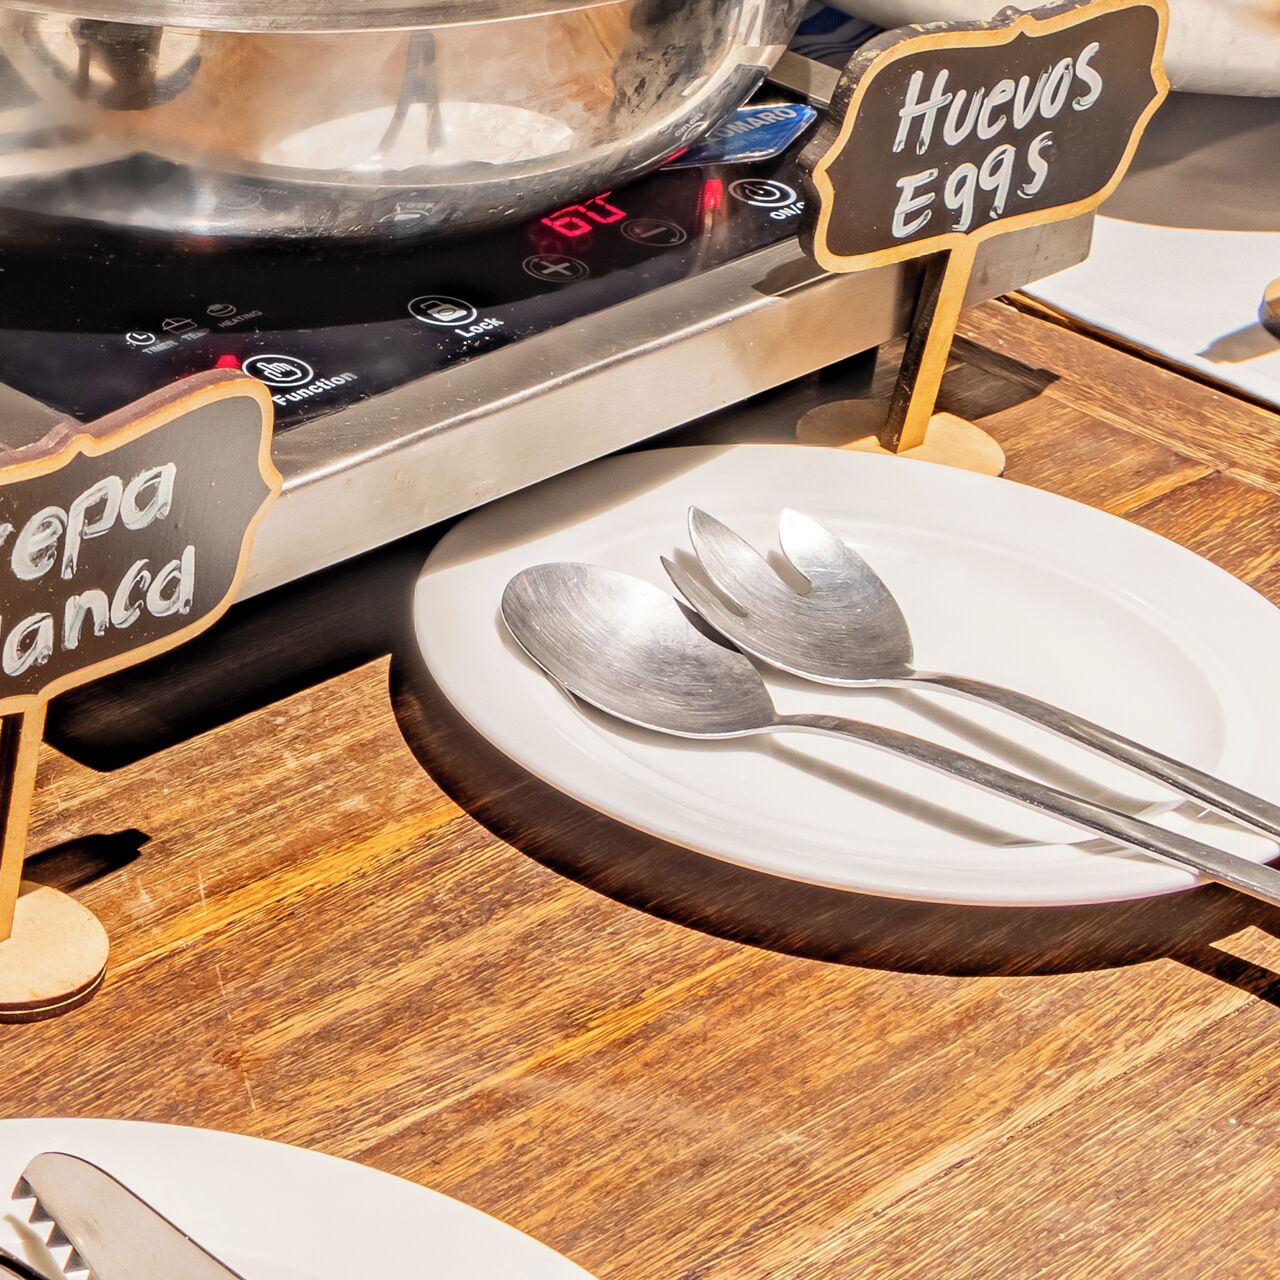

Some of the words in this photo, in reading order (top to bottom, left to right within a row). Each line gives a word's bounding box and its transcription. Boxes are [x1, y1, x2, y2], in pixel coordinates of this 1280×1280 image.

[891, 131, 1054, 238] Eggs
[217, 310, 263, 329] HEATING
[454, 317, 505, 339] Lock
[272, 371, 359, 406] Function
